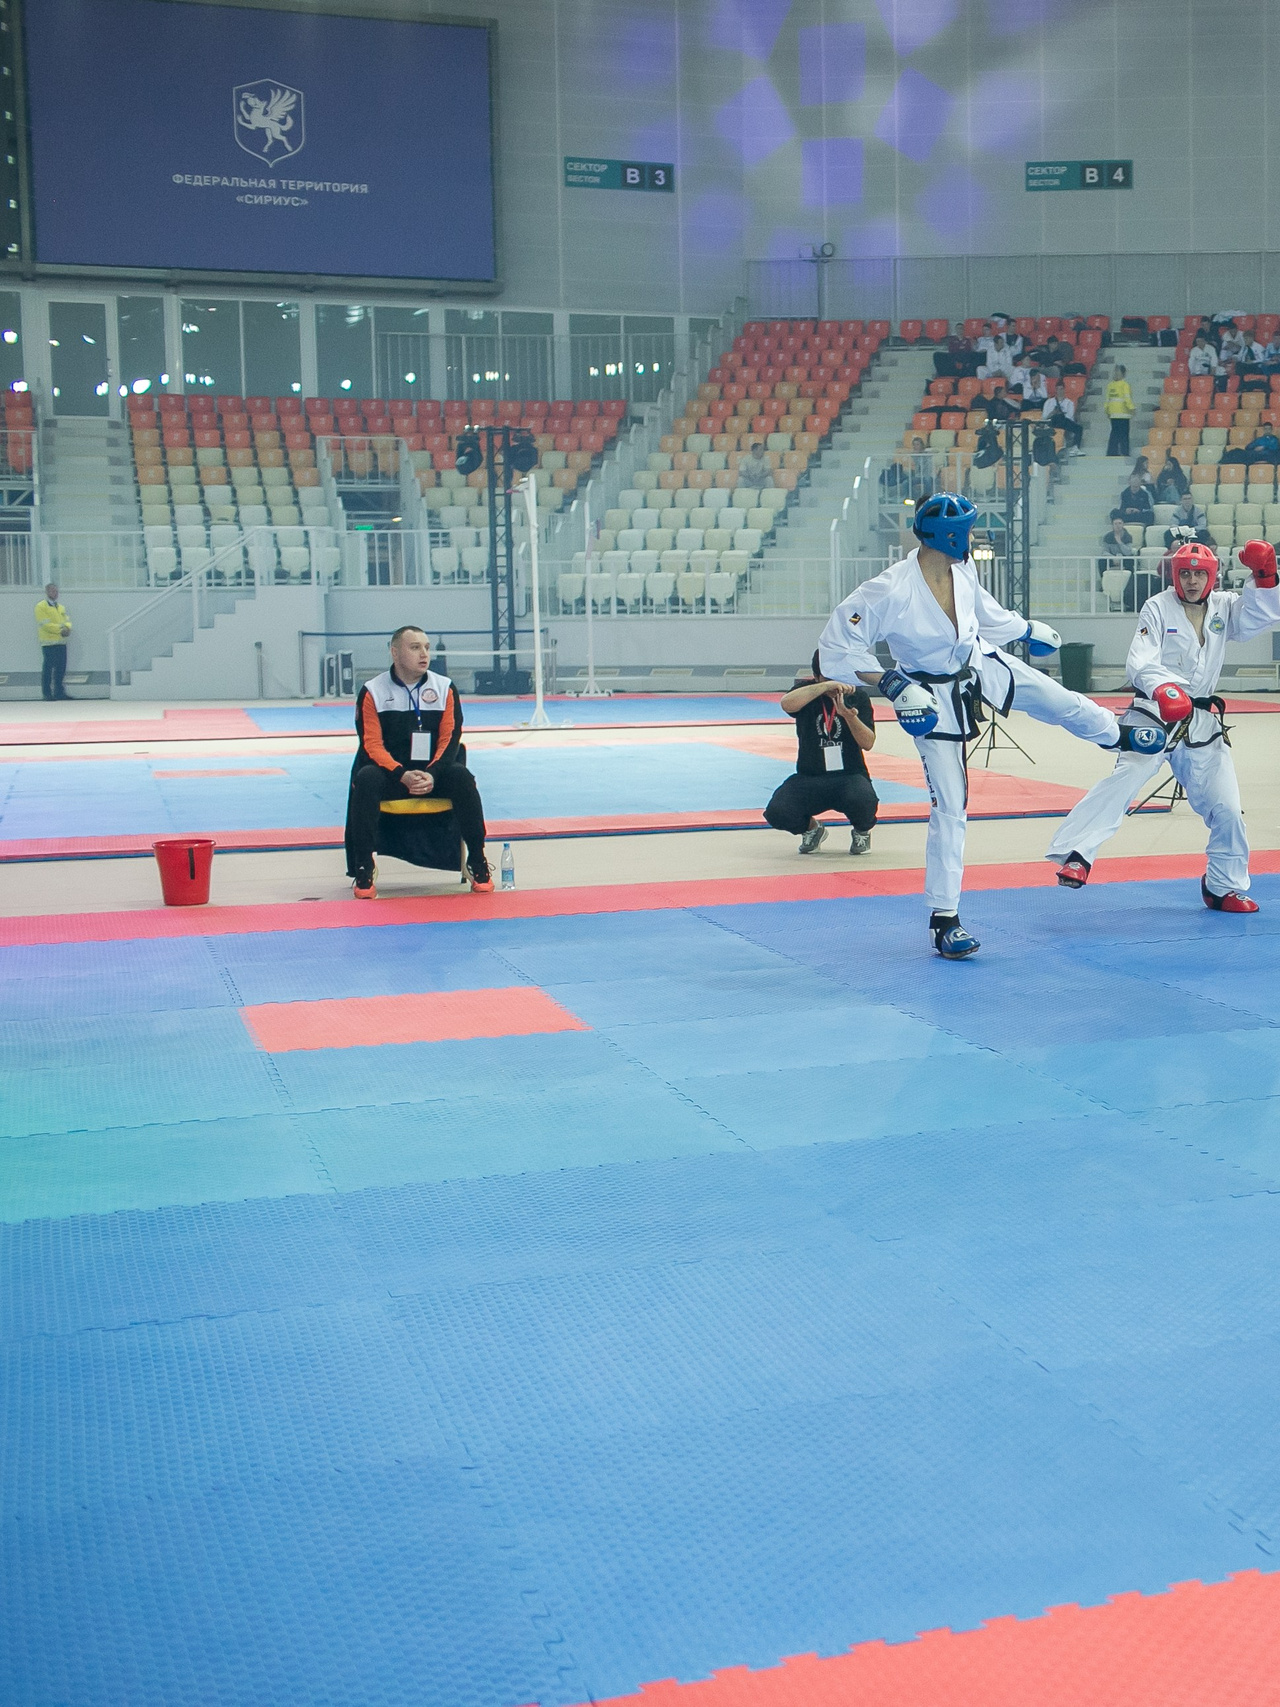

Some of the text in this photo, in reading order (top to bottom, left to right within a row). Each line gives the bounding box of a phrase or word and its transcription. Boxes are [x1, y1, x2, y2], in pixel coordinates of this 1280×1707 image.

[566, 162, 608, 173] СЕКТОР
[1027, 165, 1068, 176] СЕКТОР
[1112, 166, 1125, 183] 4
[171, 173, 369, 194] ФЕДЕРАЛЬНАЯ ТЕРРИТОРИЯ
[654, 169, 666, 186] 3
[236, 194, 309, 207] «СИРИУС»
